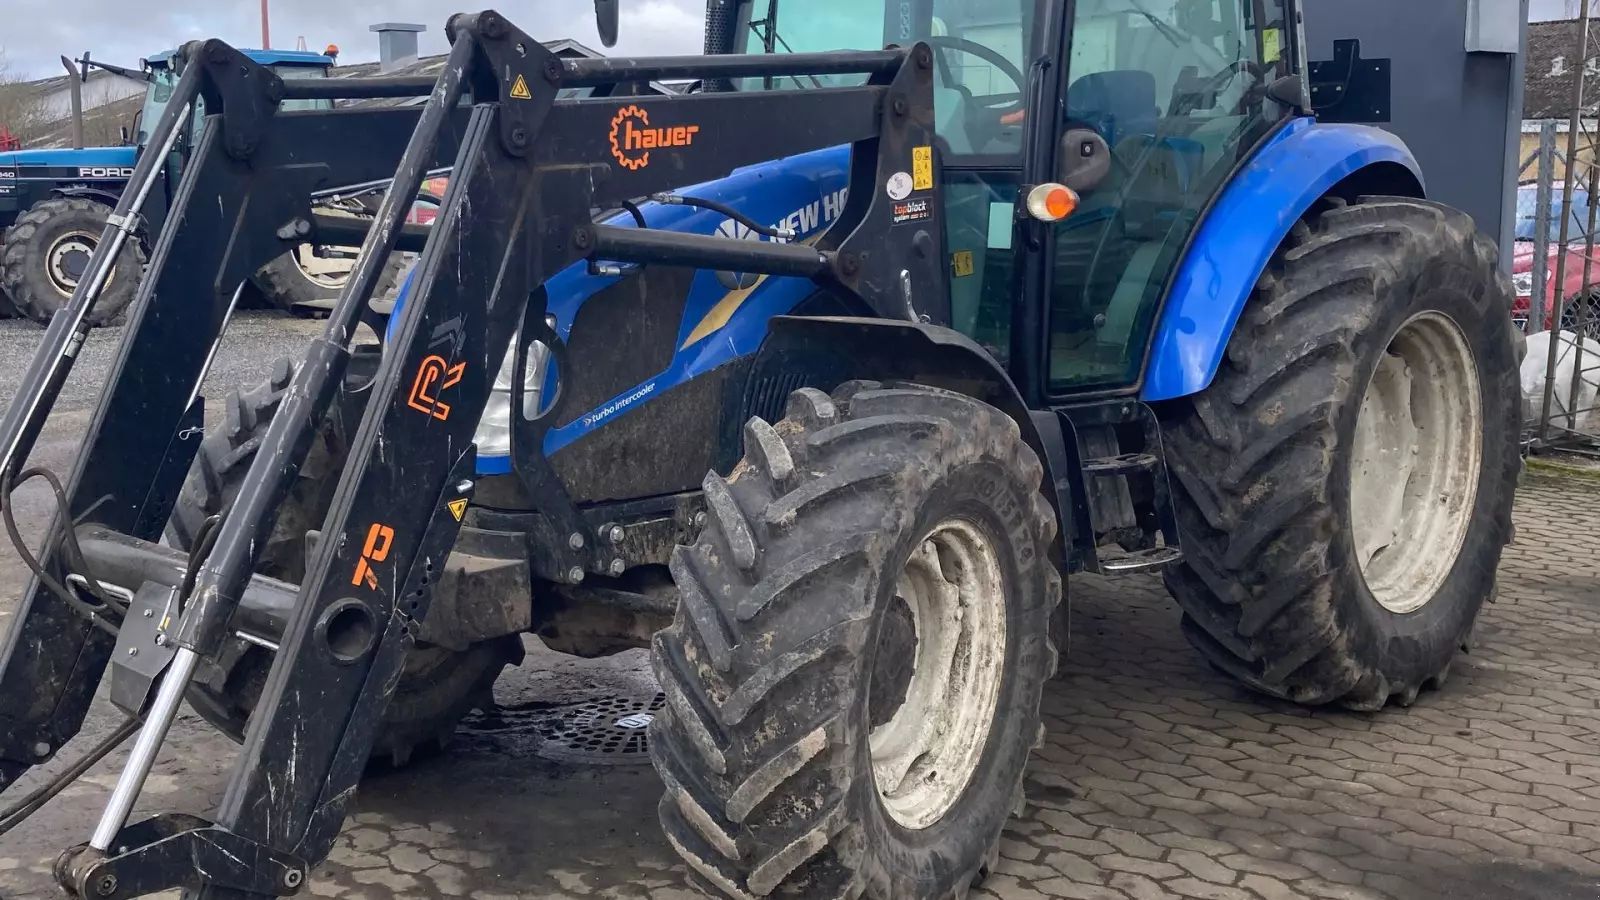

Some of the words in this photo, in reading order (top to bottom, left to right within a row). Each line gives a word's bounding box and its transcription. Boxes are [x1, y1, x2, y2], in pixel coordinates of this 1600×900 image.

[625, 120, 699, 150] hauer
[80, 167, 135, 177] FORD
[894, 200, 928, 215] topblock
[591, 406, 615, 423] turbo
[615, 382, 656, 411] intercooler
